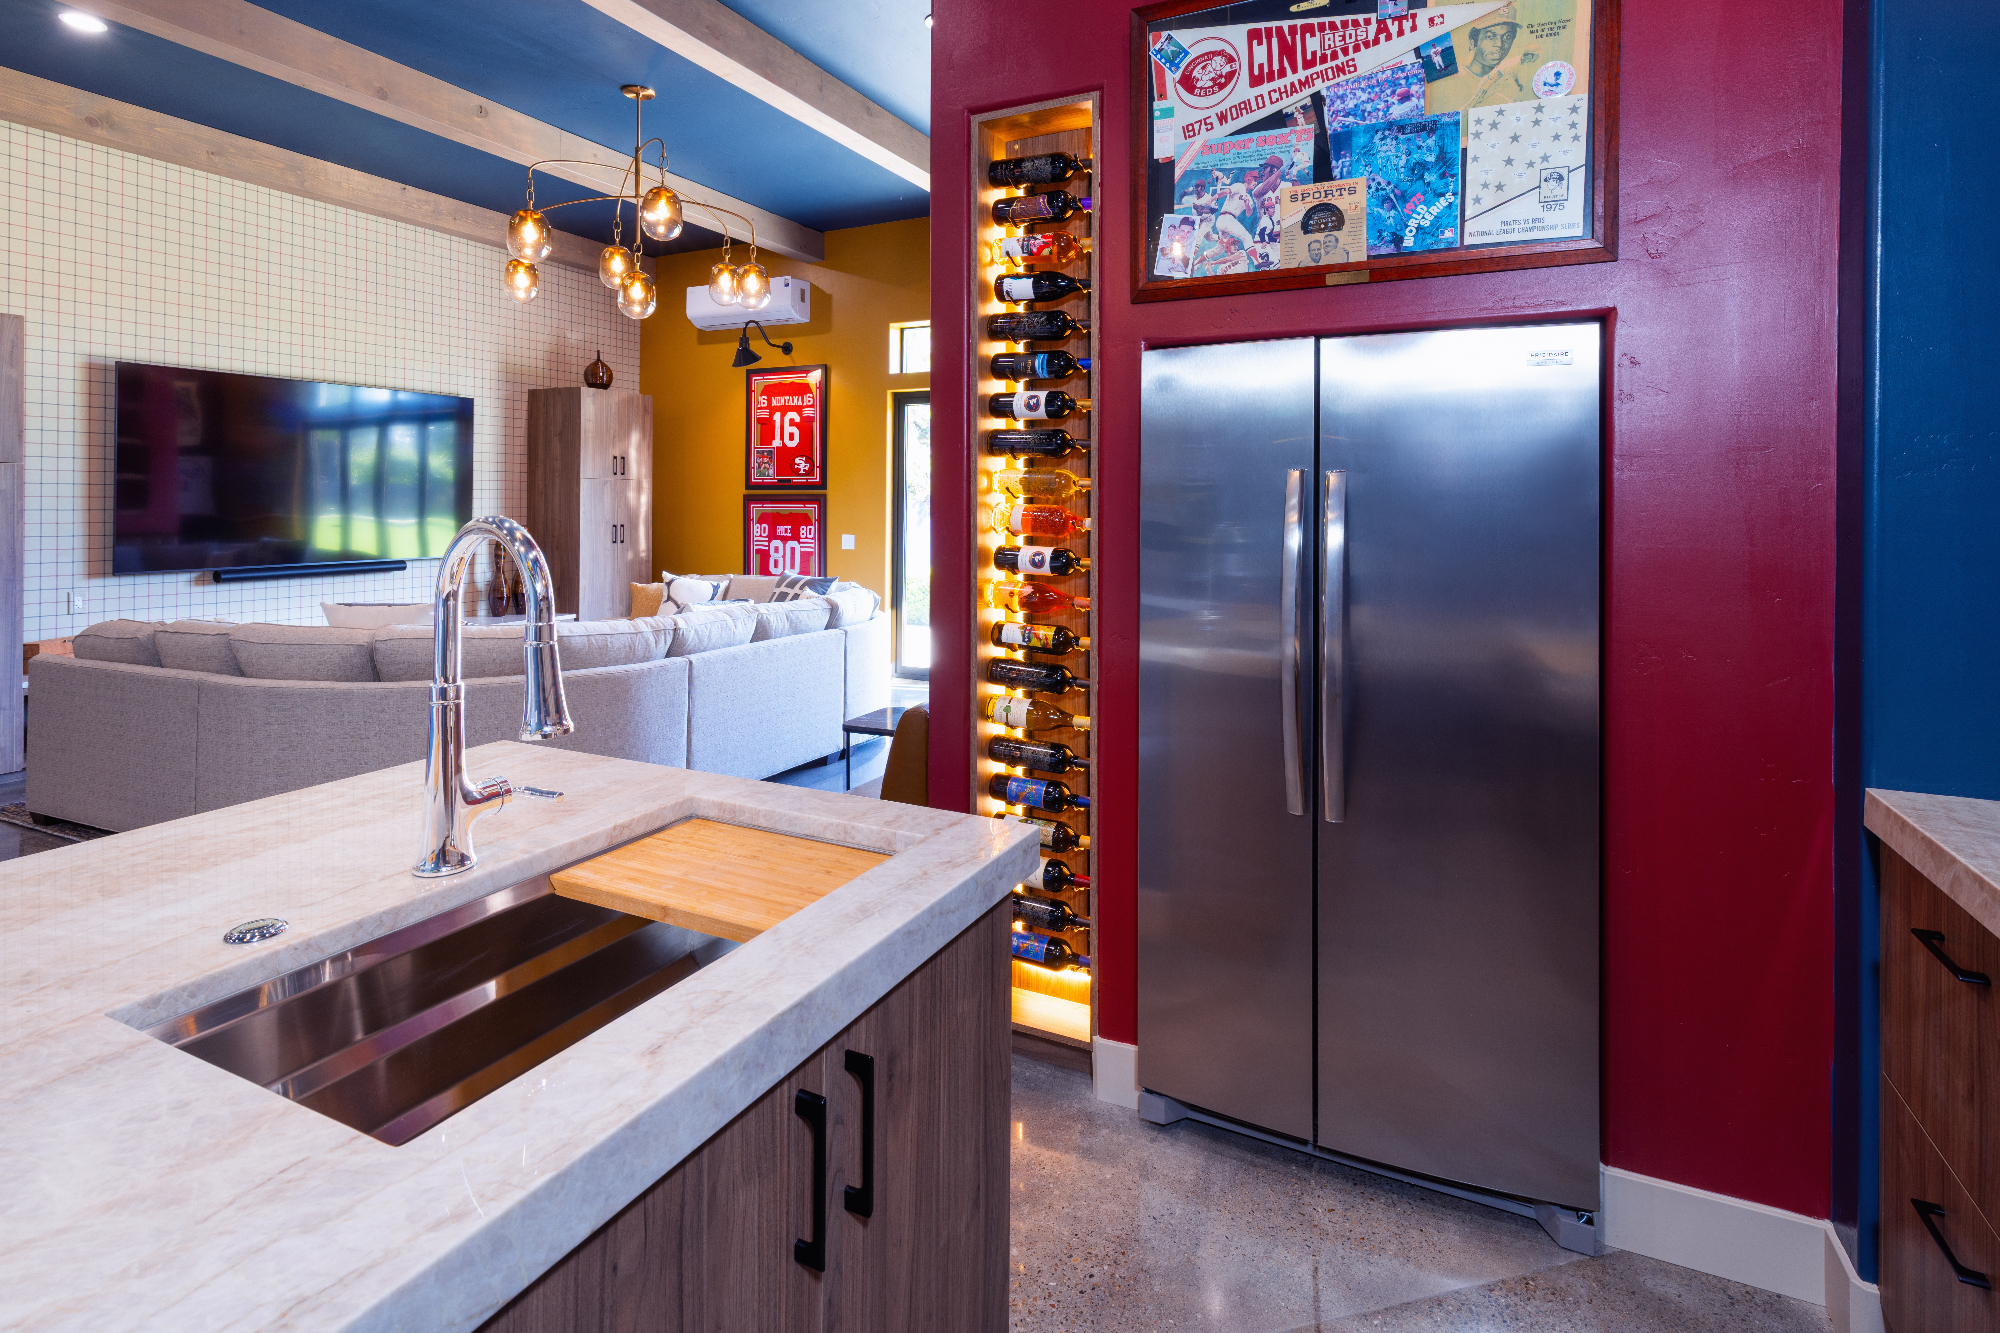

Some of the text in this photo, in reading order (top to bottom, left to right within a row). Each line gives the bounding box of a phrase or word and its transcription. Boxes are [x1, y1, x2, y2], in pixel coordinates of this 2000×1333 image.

[1323, 27, 1368, 50] REDS
[1247, 12, 1418, 88] CINCINNATI
[1185, 54, 1213, 75] CINCINNATI
[1182, 116, 1214, 140] 1975
[1215, 94, 1266, 127] WORLD
[1268, 57, 1358, 106] CHAMPIONS
[1194, 86, 1219, 96] REDS
[1200, 136, 1255, 157] super
[1256, 132, 1292, 148] sox
[1290, 186, 1357, 203] SPORTS
[1403, 192, 1425, 216] 1975
[1420, 192, 1455, 227] SERIES
[1541, 202, 1565, 213] 1975
[1403, 204, 1428, 247] WORLD
[1468, 222, 1581, 238] NATIONAL LEAGUE CHAMPIONSHIP SERIES
[1500, 219, 1522, 227] PIRATES
[758, 393, 814, 407] 16 MONTANA 16
[771, 411, 801, 448] 16
[794, 456, 810, 474] SF
[755, 523, 815, 539] 80 RICE 80
[769, 539, 801, 575] 80
